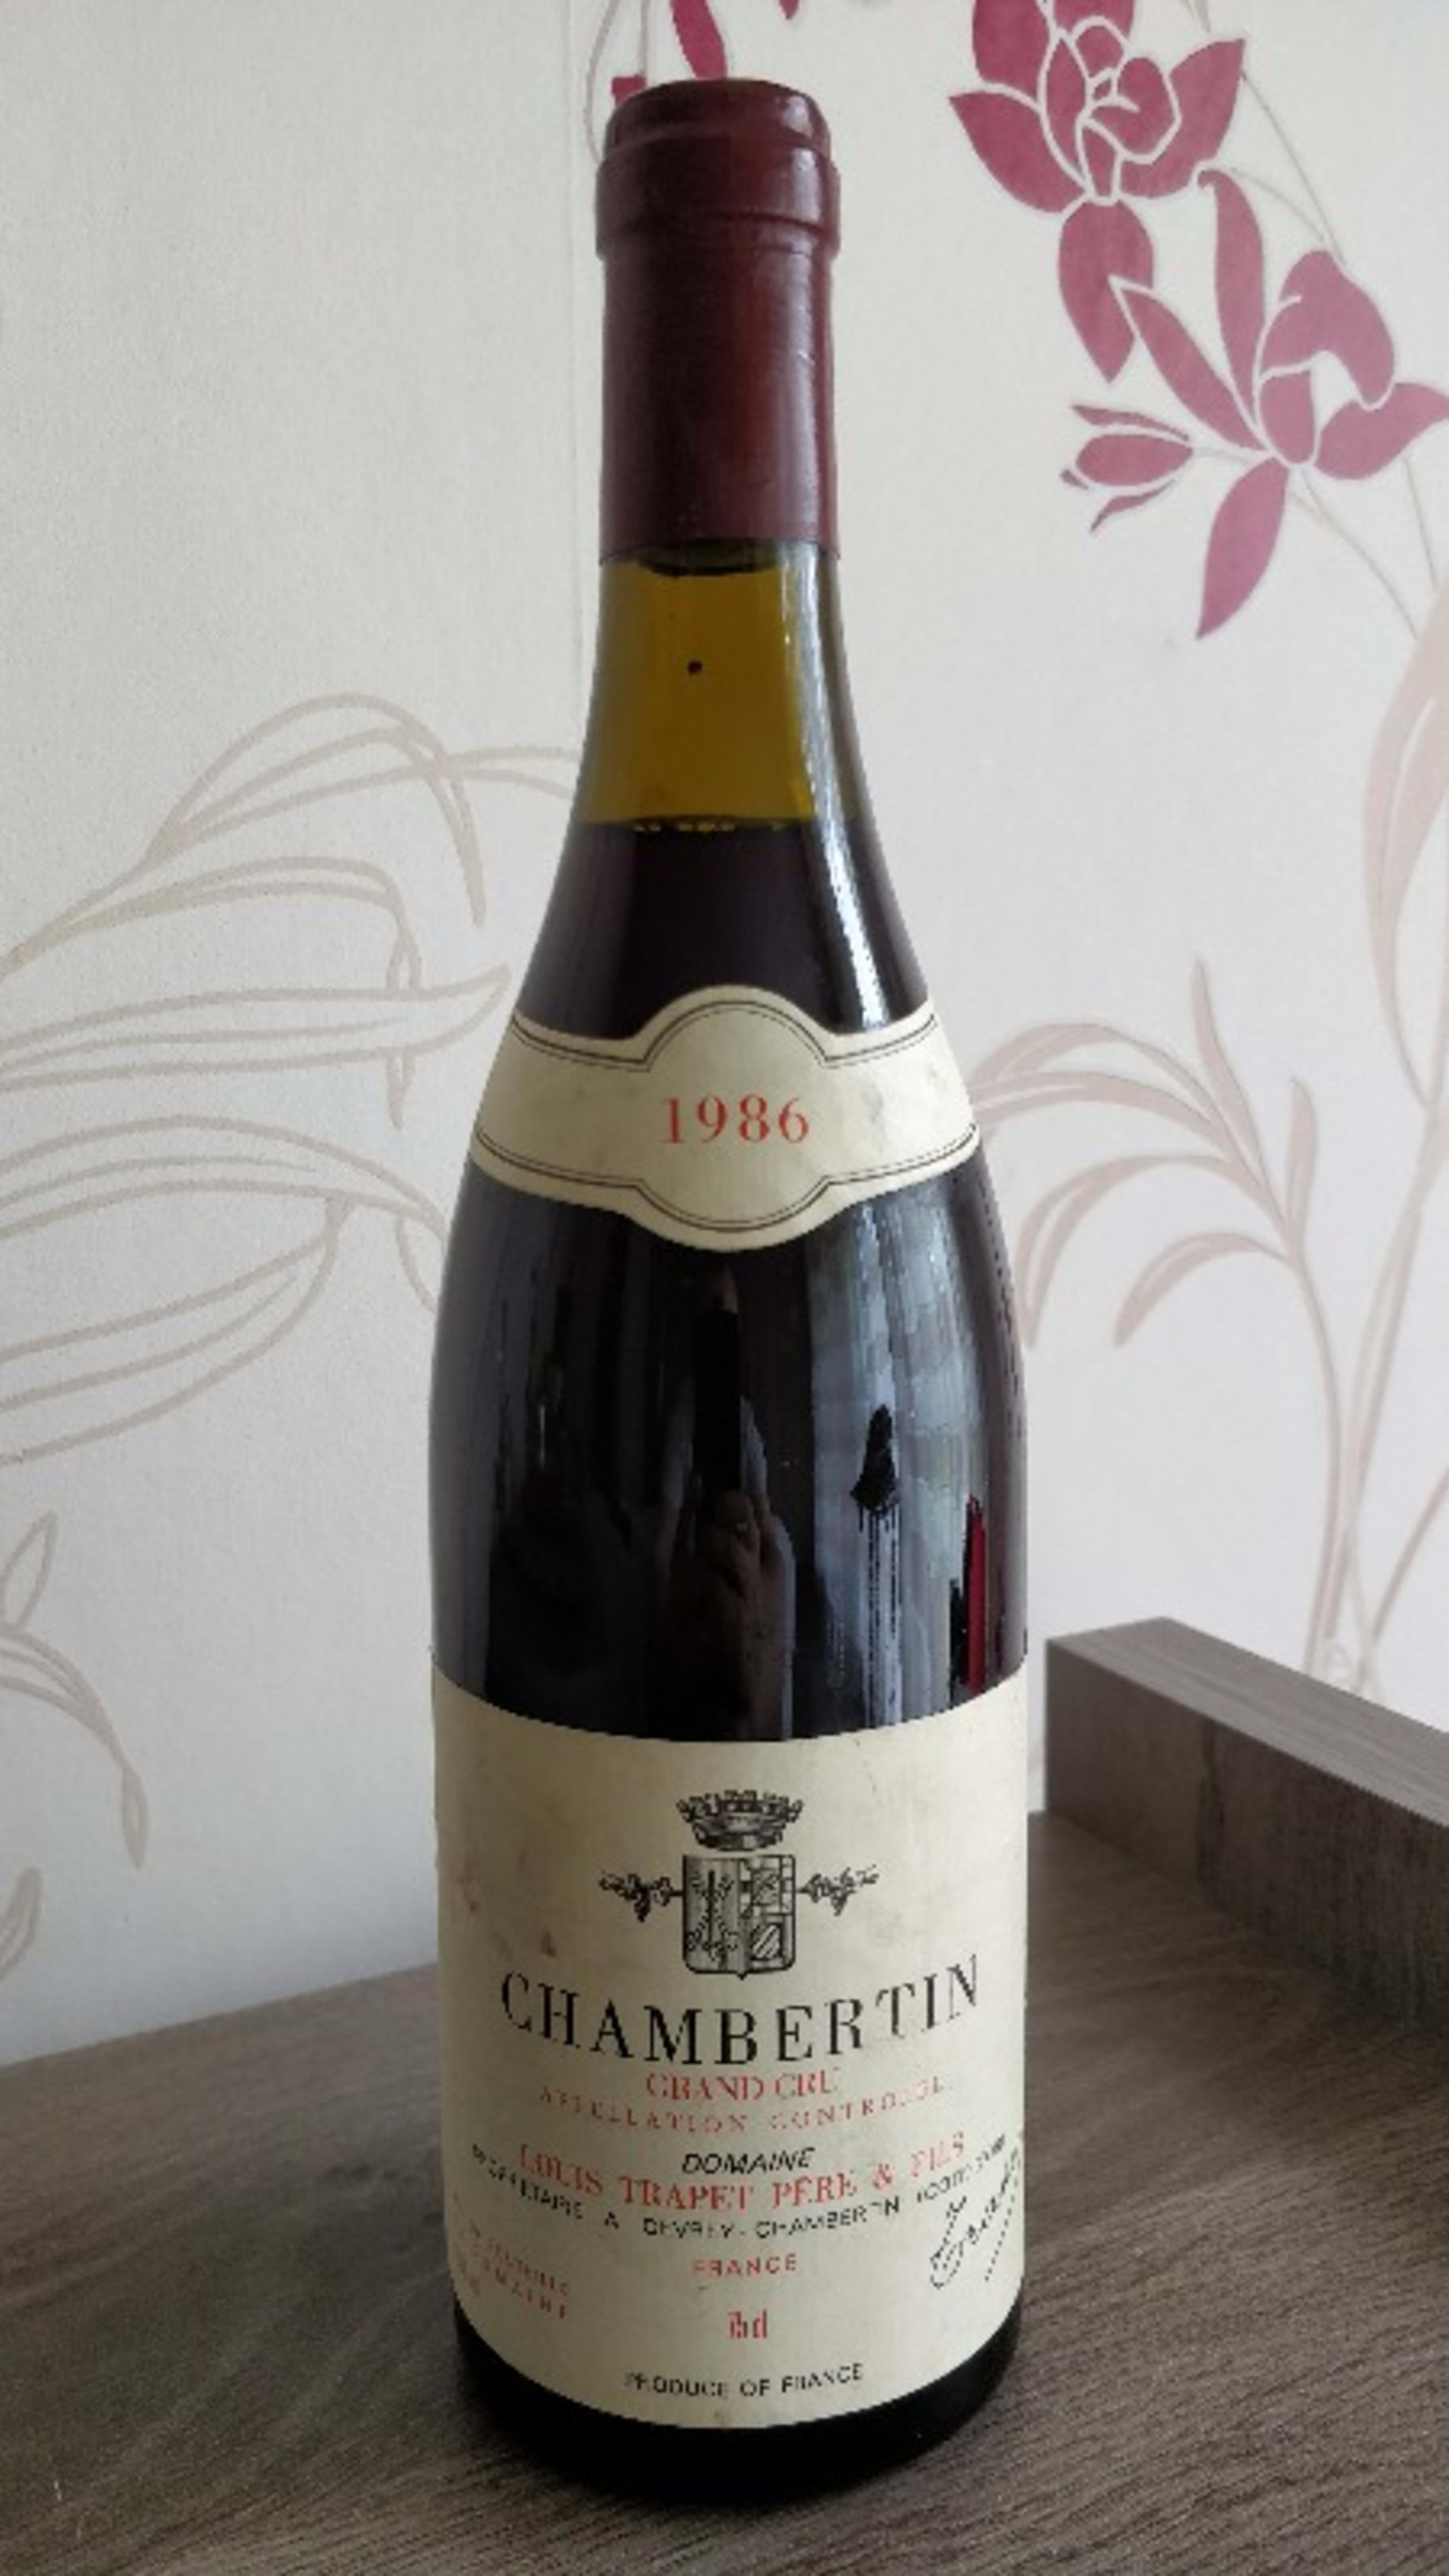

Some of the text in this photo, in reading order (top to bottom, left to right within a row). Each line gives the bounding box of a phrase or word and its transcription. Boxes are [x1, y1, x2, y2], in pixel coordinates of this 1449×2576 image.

[663, 1094, 809, 1145] 1986
[500, 1953, 979, 2066] CHAMBERTIN
[645, 2067, 840, 2101] GRAND CRU
[520, 2143, 603, 2195] LOUIS
[618, 2176, 754, 2210] TRAPET
[872, 2163, 893, 2190] &
[681, 2147, 816, 2175] DOMAINE
[693, 2254, 796, 2278] FRANCE
[624, 2363, 864, 2399] PRODUCE OF FRANCE
